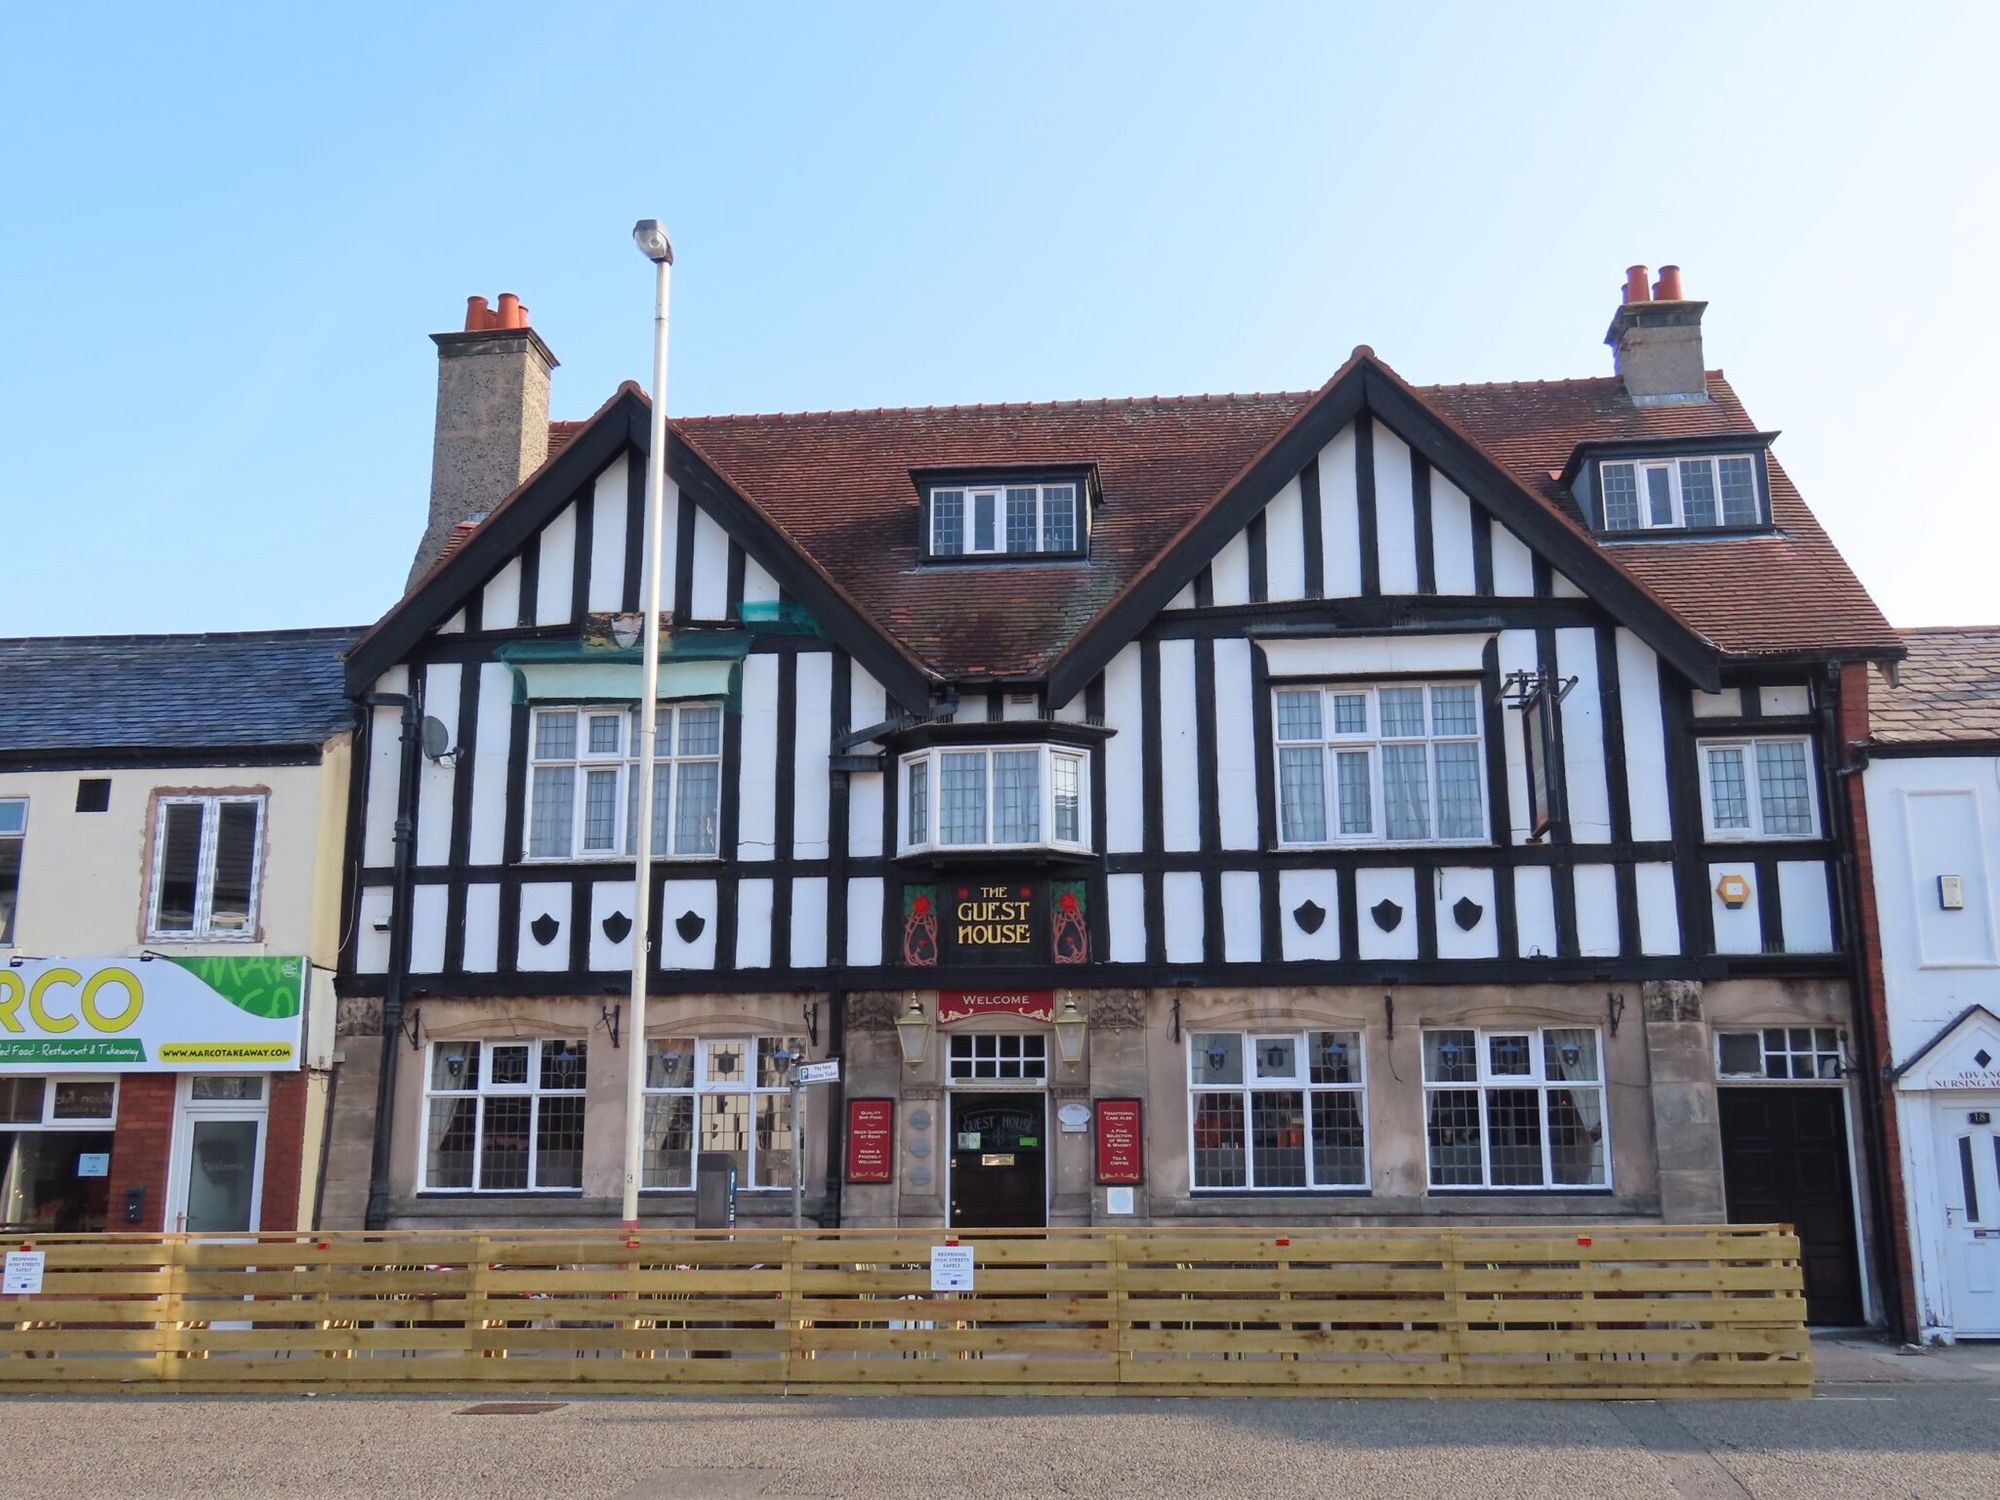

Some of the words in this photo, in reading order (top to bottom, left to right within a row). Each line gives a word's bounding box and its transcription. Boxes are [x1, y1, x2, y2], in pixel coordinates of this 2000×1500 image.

[981, 887, 1008, 898] THE
[957, 901, 1030, 921] GUEST
[957, 924, 1031, 944] HOUSE
[962, 995, 1030, 1005] WELCOME
[12, 1043, 35, 1056] Food
[42, 1043, 88, 1056] Restaurant
[98, 1043, 139, 1061] Takeaway
[163, 1048, 291, 1058] WWW.MARCOTAKEAWAY.COM
[1935, 1080, 1985, 1088] NURSING
[1974, 1111, 1986, 1122] 18
